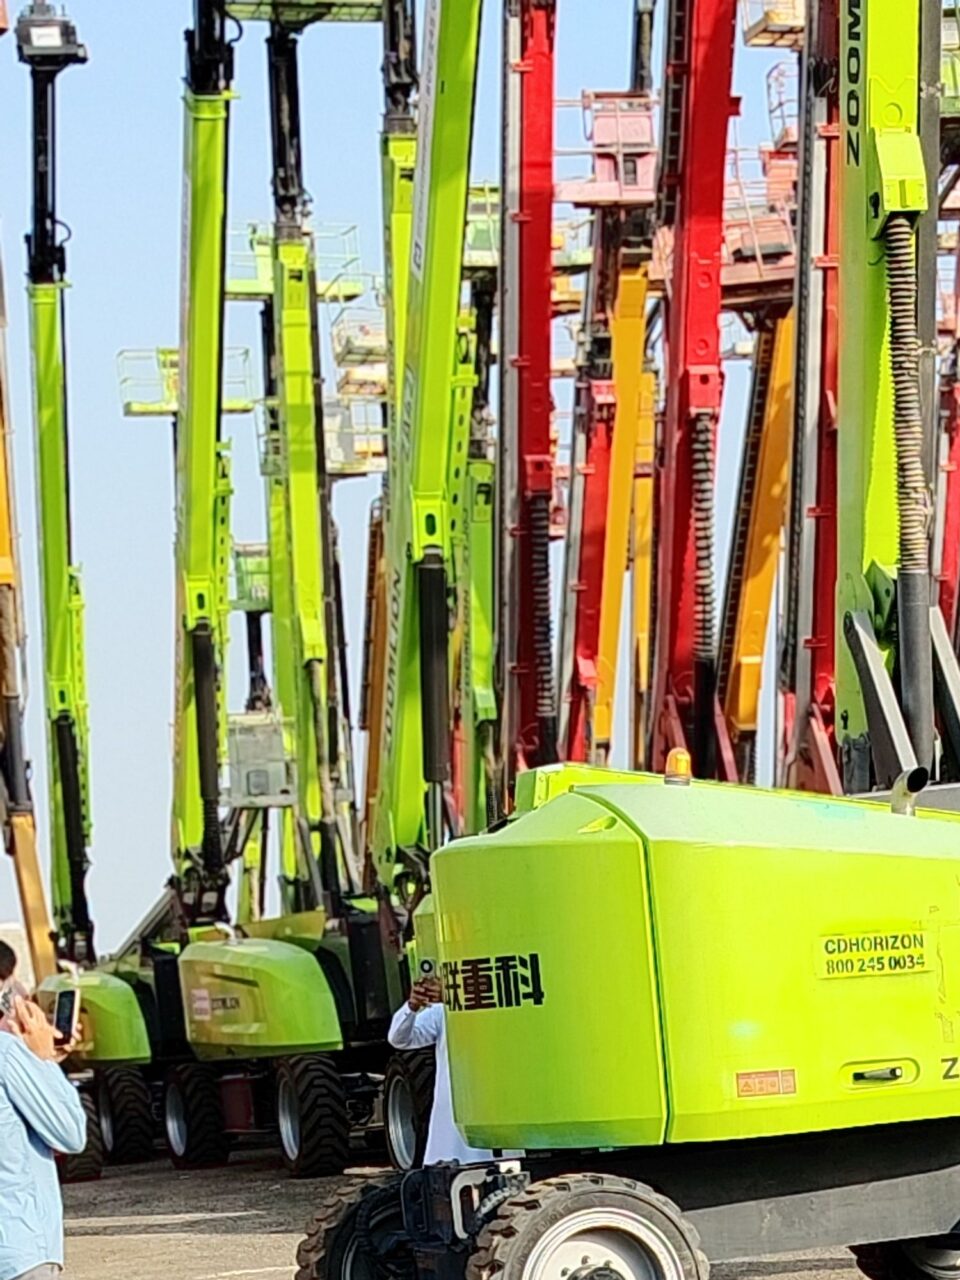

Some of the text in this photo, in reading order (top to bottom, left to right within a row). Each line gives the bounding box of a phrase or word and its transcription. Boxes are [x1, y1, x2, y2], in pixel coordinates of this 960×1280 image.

[824, 933, 924, 954] CDHORIZON
[826, 953, 925, 975] 800 245 0034
